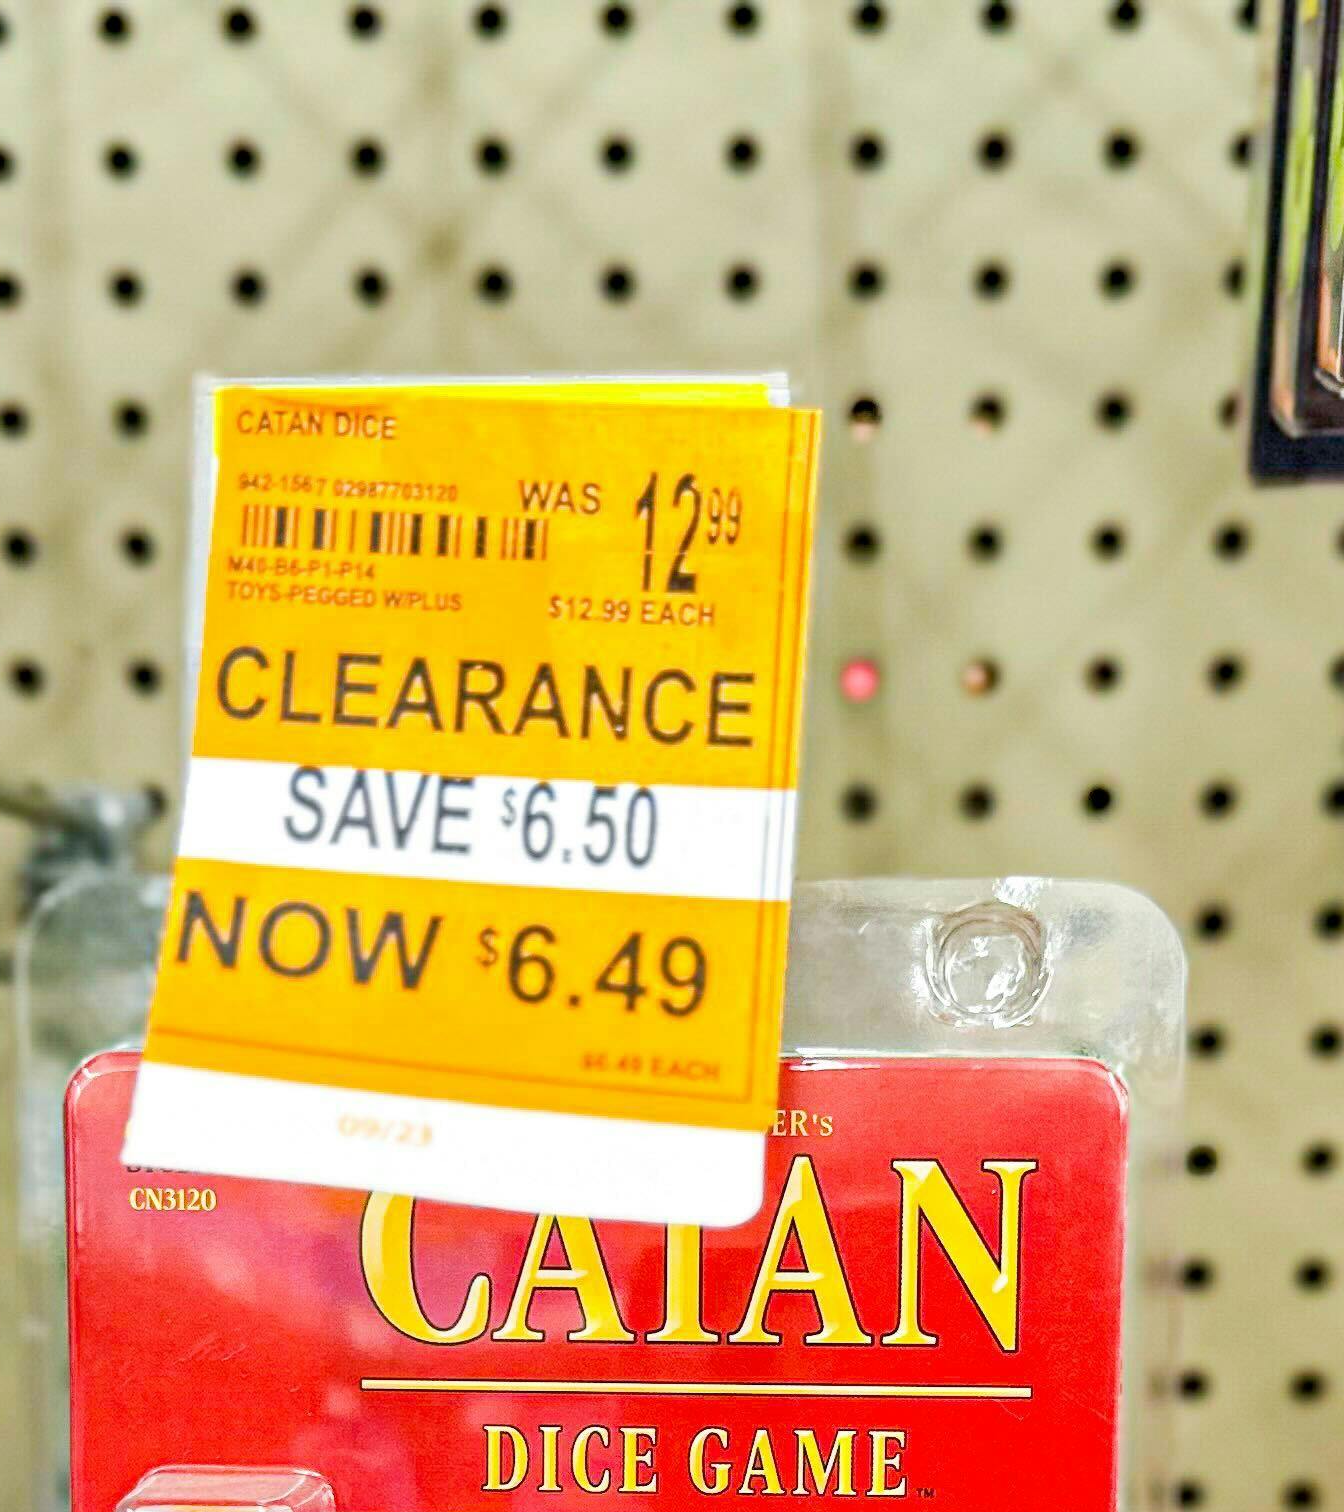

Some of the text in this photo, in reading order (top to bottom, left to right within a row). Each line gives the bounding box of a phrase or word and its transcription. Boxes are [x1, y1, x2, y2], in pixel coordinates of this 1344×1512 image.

[236, 409, 399, 442] CATAN DICE
[519, 480, 603, 517] WAS
[226, 580, 378, 609] TOYS-PEGGED
[547, 595, 717, 628] $12.99 EACH
[215, 644, 758, 750] CLEARANCE
[282, 764, 659, 868] SAVE $6.50
[175, 889, 710, 1018] NOW $6.49
[652, 1055, 722, 1086] EACH
[128, 1186, 218, 1212] CN3120
[482, 1424, 909, 1498] DICE GAME
